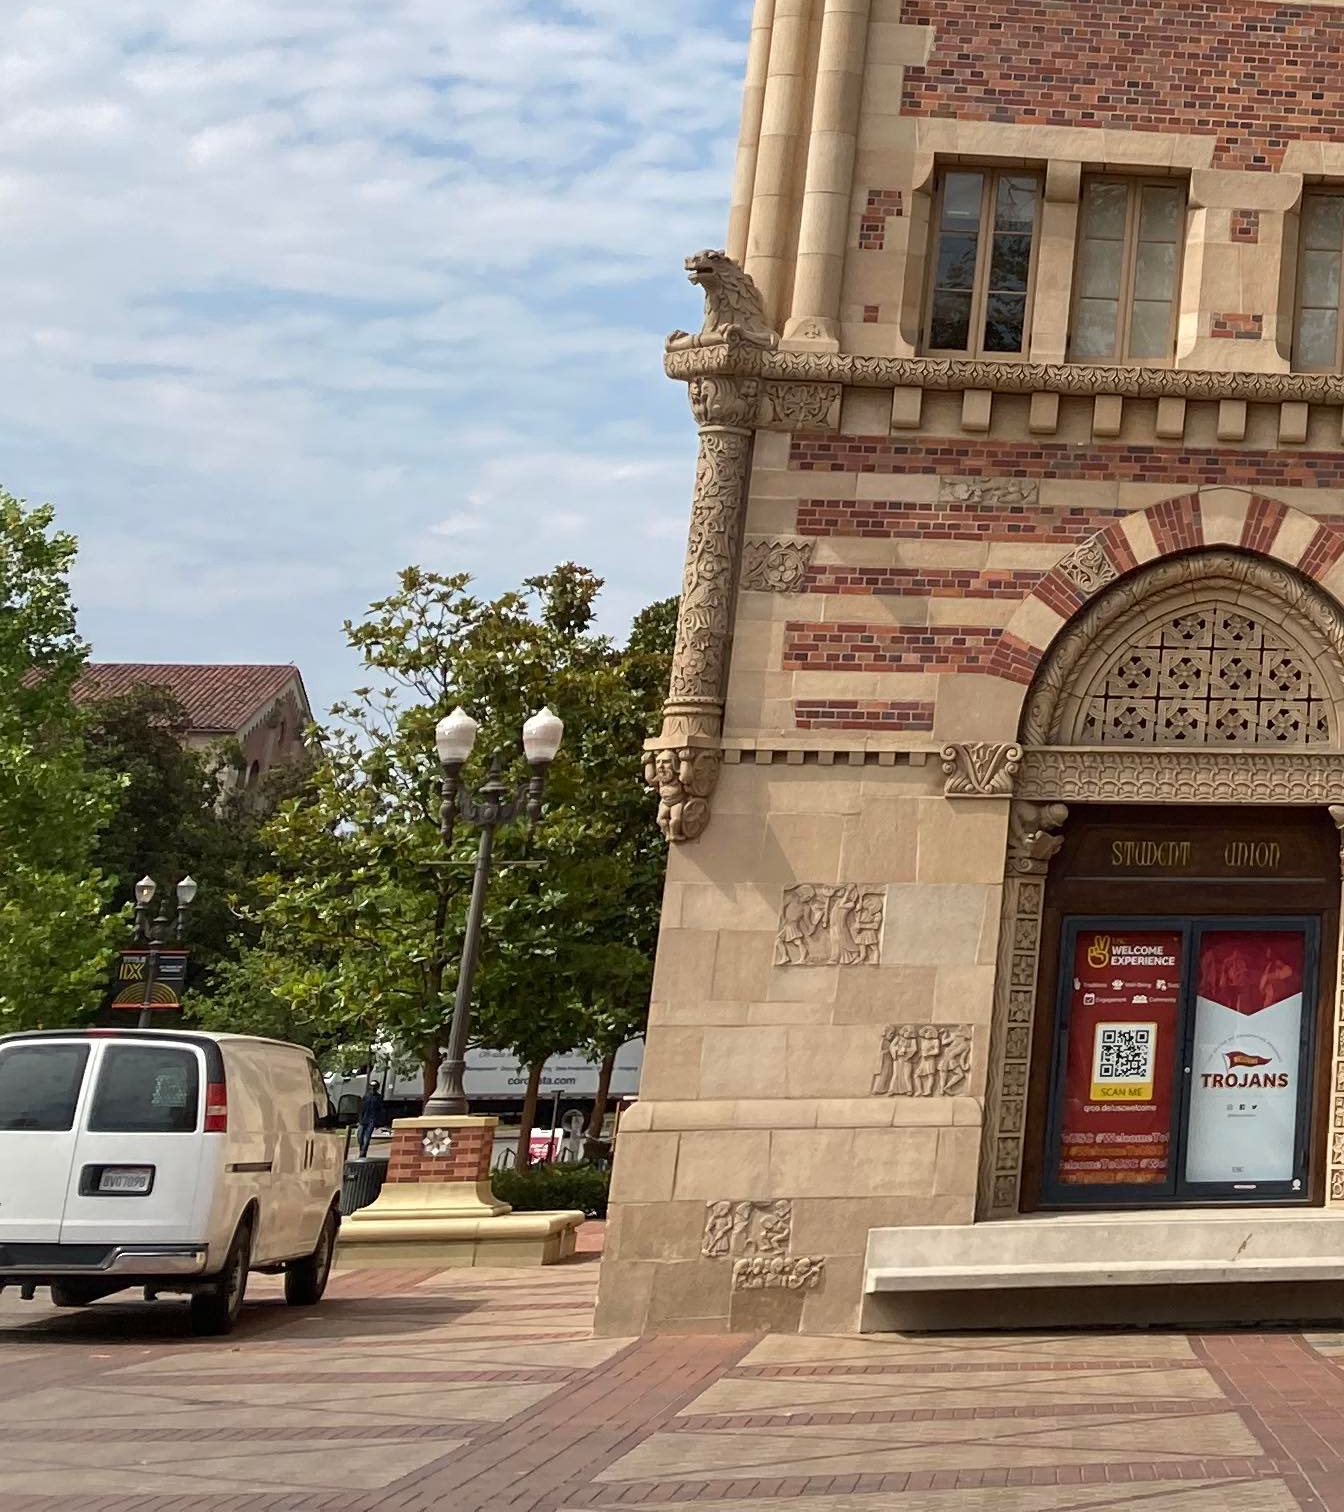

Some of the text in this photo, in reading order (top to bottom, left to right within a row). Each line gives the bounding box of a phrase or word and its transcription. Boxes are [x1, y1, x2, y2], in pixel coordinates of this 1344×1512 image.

[1112, 841, 1281, 869] STUDENT UNION
[1111, 945, 1164, 956] WELCOME
[1110, 956, 1176, 966] EXPERIENCE
[1200, 1072, 1290, 1089] TROJANS
[1101, 1087, 1143, 1097] SCAN ME
